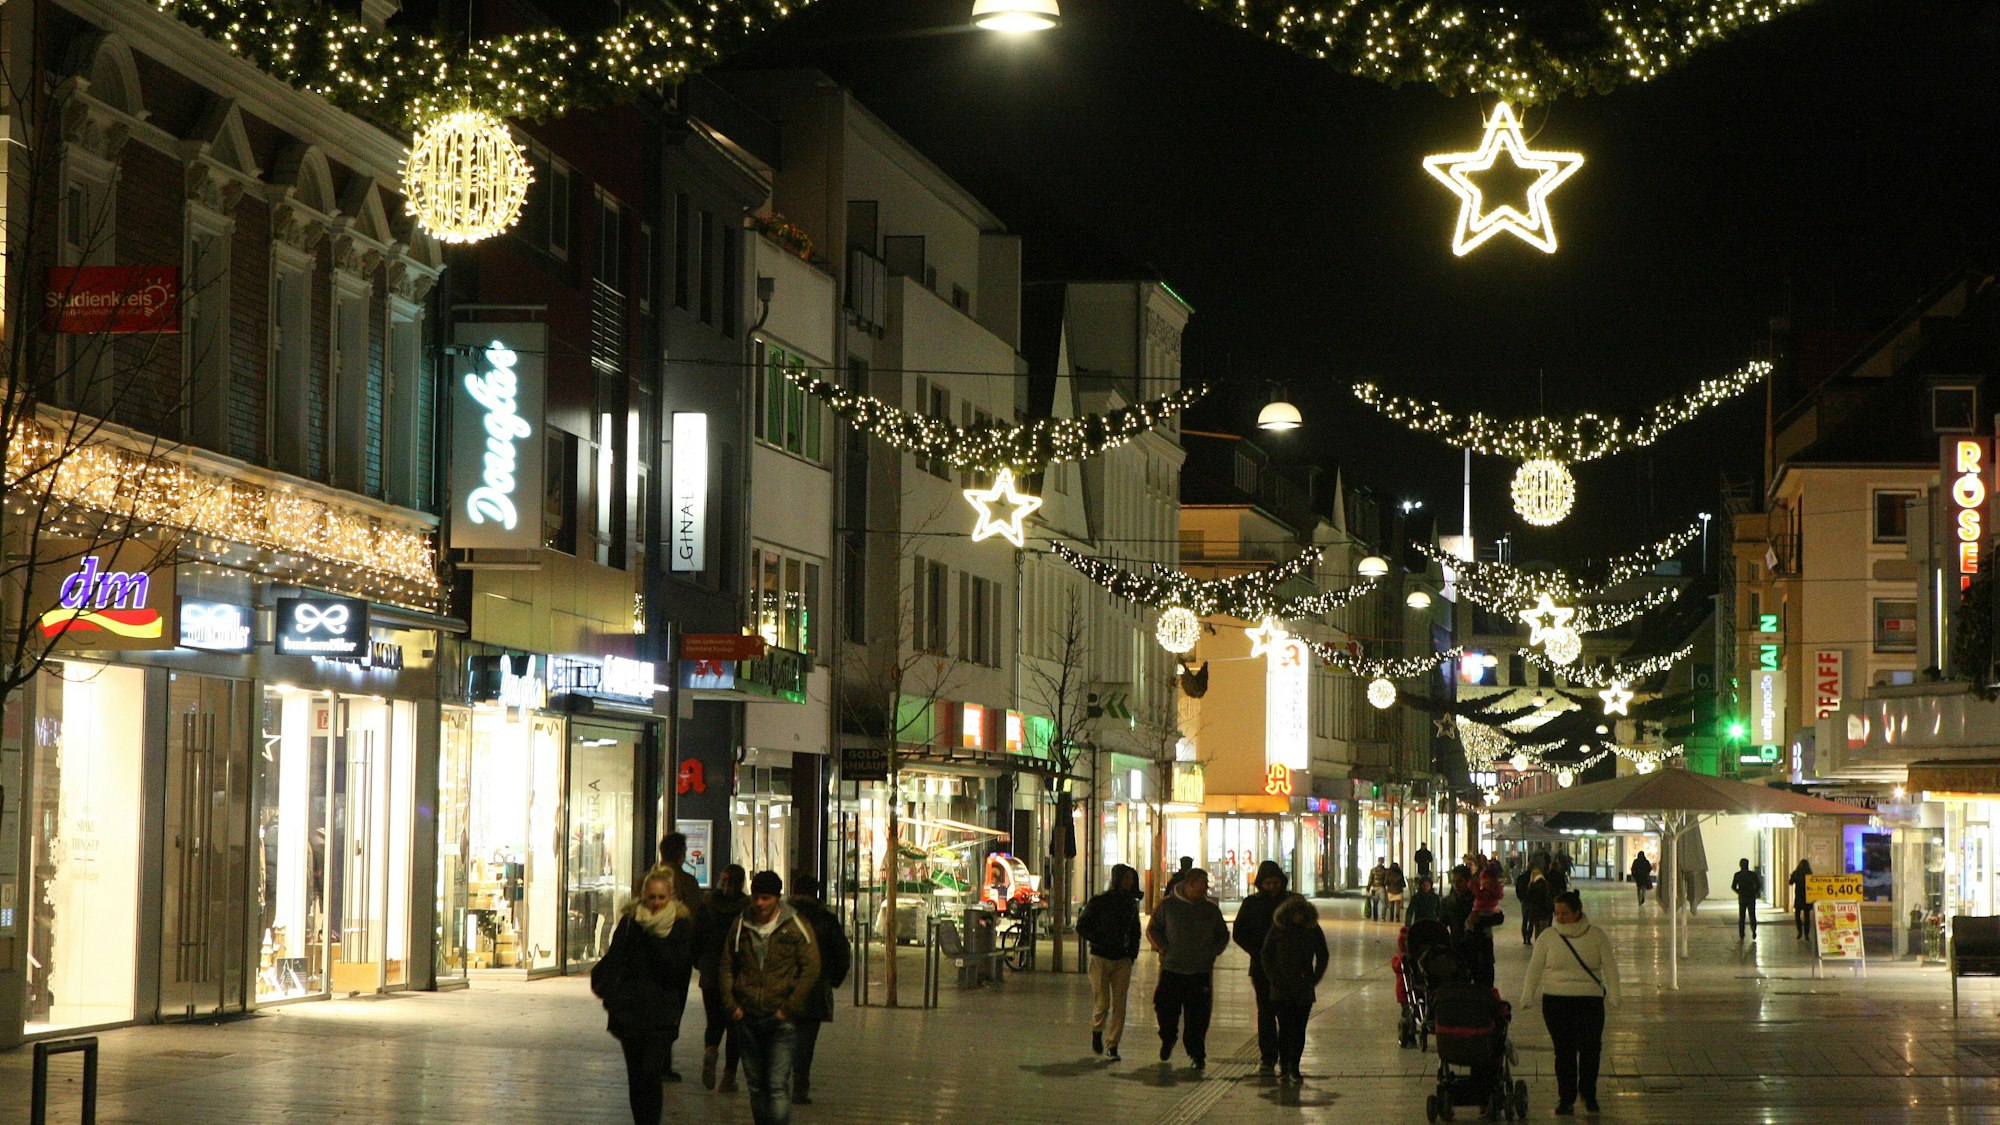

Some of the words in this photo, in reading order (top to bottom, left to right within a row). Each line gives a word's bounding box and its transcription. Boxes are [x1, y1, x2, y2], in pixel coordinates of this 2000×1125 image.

[465, 340, 531, 530] Douglas
[61, 556, 149, 609] dm
[848, 750, 880, 760] GOLD
